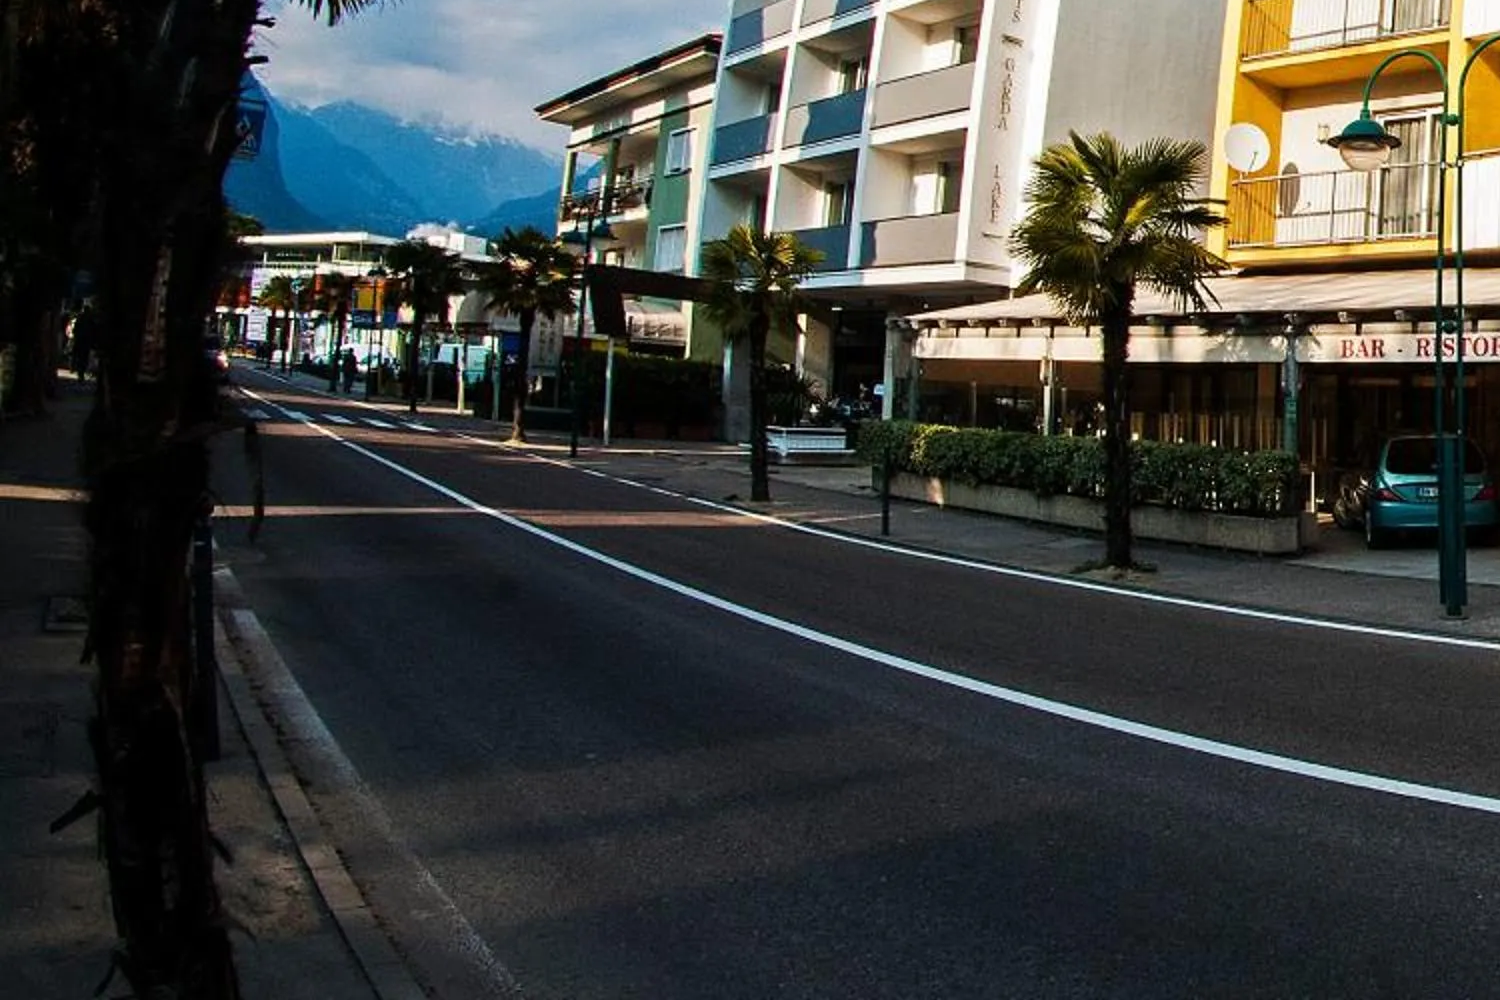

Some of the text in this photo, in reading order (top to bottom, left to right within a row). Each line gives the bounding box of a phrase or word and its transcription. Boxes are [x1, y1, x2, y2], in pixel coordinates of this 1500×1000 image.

[997, 57, 1016, 131] GARDA
[989, 164, 1004, 224] LAKE
[1340, 339, 1385, 359] BAR
